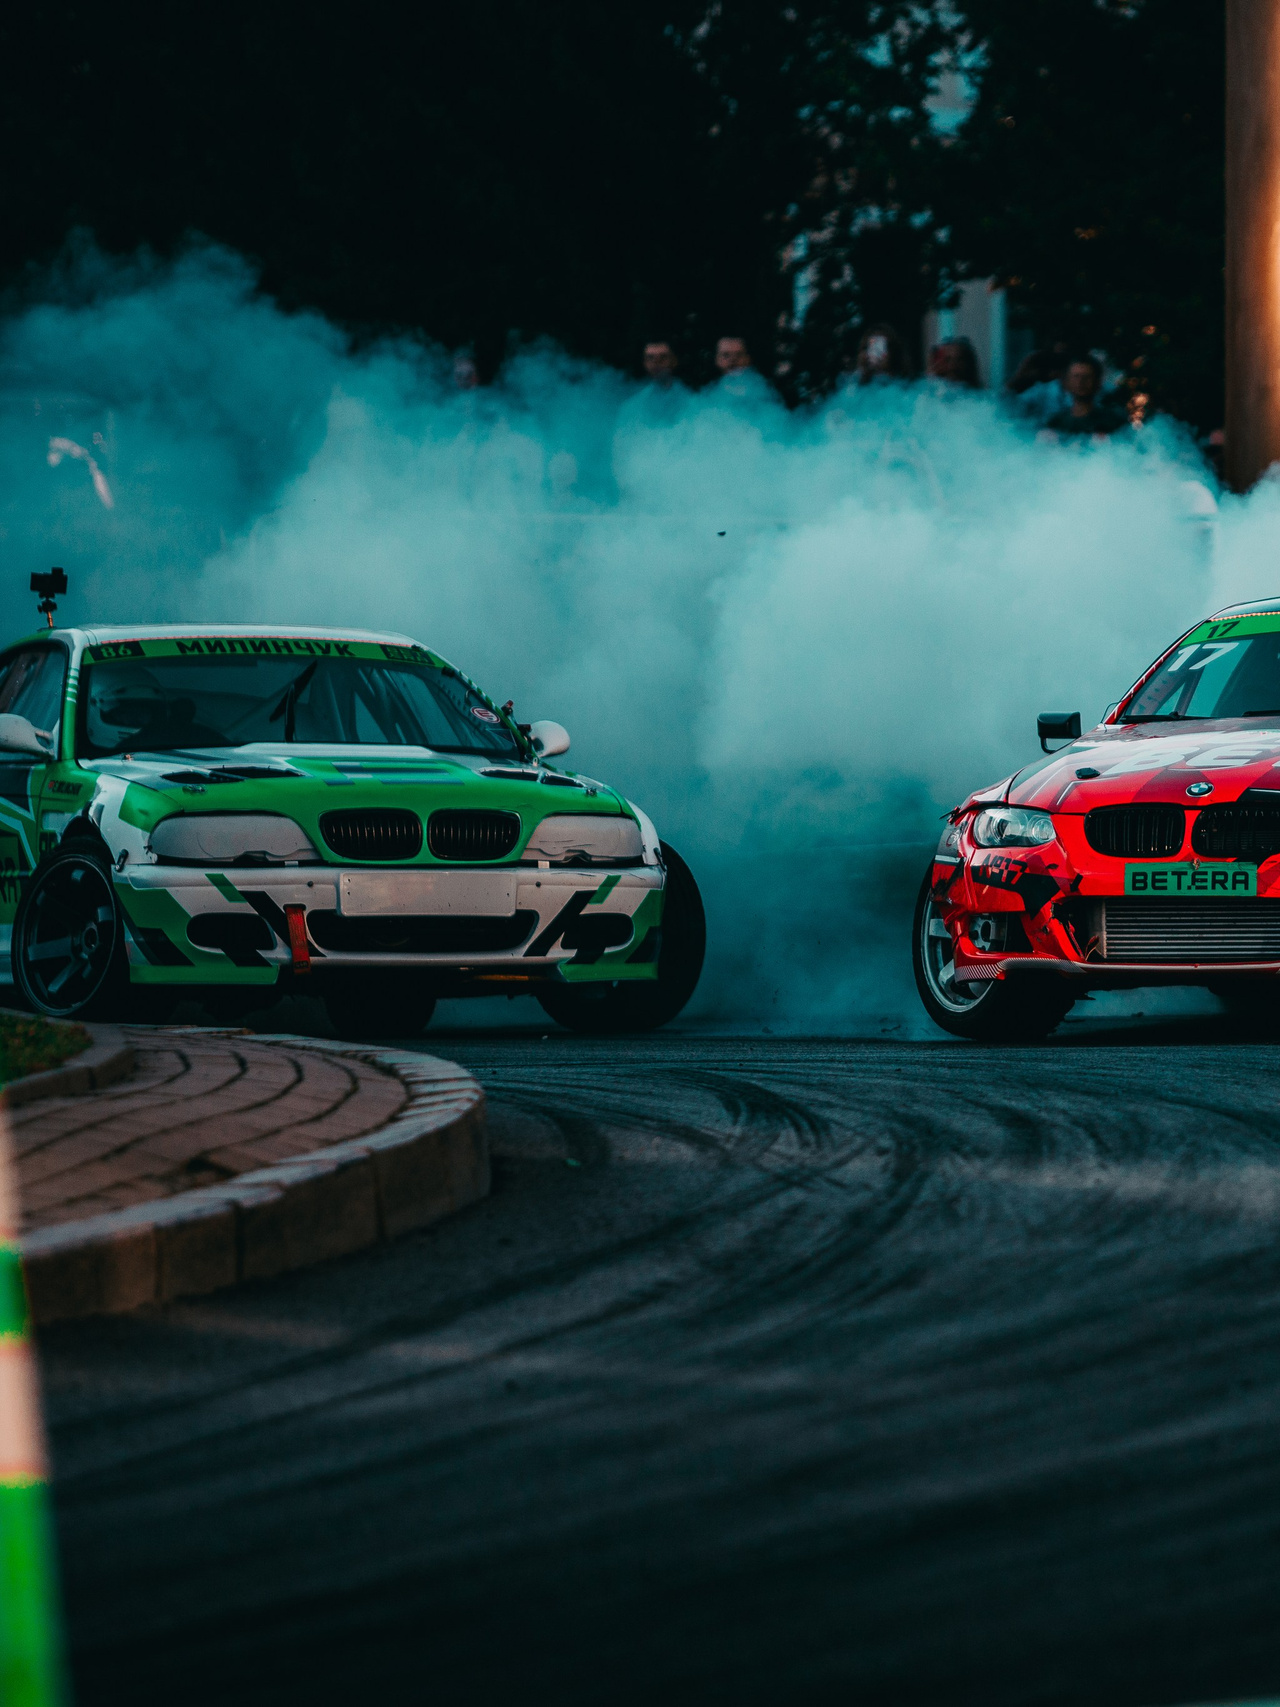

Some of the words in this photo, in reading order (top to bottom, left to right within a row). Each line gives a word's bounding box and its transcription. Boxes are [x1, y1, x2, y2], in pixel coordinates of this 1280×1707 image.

[1207, 620, 1241, 639] 17
[101, 643, 132, 658] 86
[1167, 642, 1240, 672] 17
[1131, 870, 1250, 891] BET.ERA
